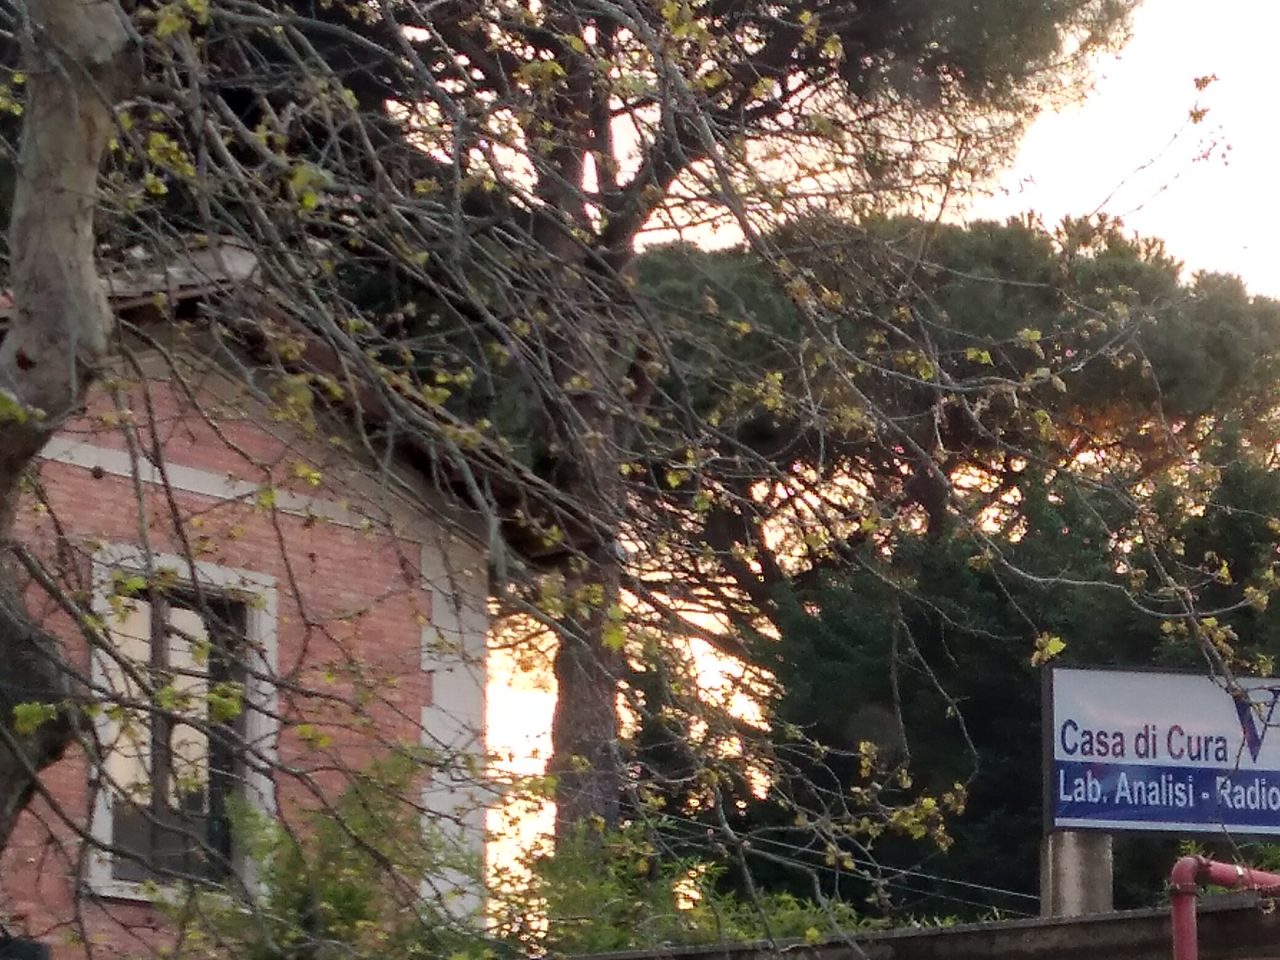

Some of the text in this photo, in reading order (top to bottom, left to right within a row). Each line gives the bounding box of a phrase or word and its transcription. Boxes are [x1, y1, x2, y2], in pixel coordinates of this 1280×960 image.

[1060, 719, 1228, 762] Casa di Cura
[1059, 769, 1107, 804] Lab.
[1115, 771, 1194, 808] Analisi
